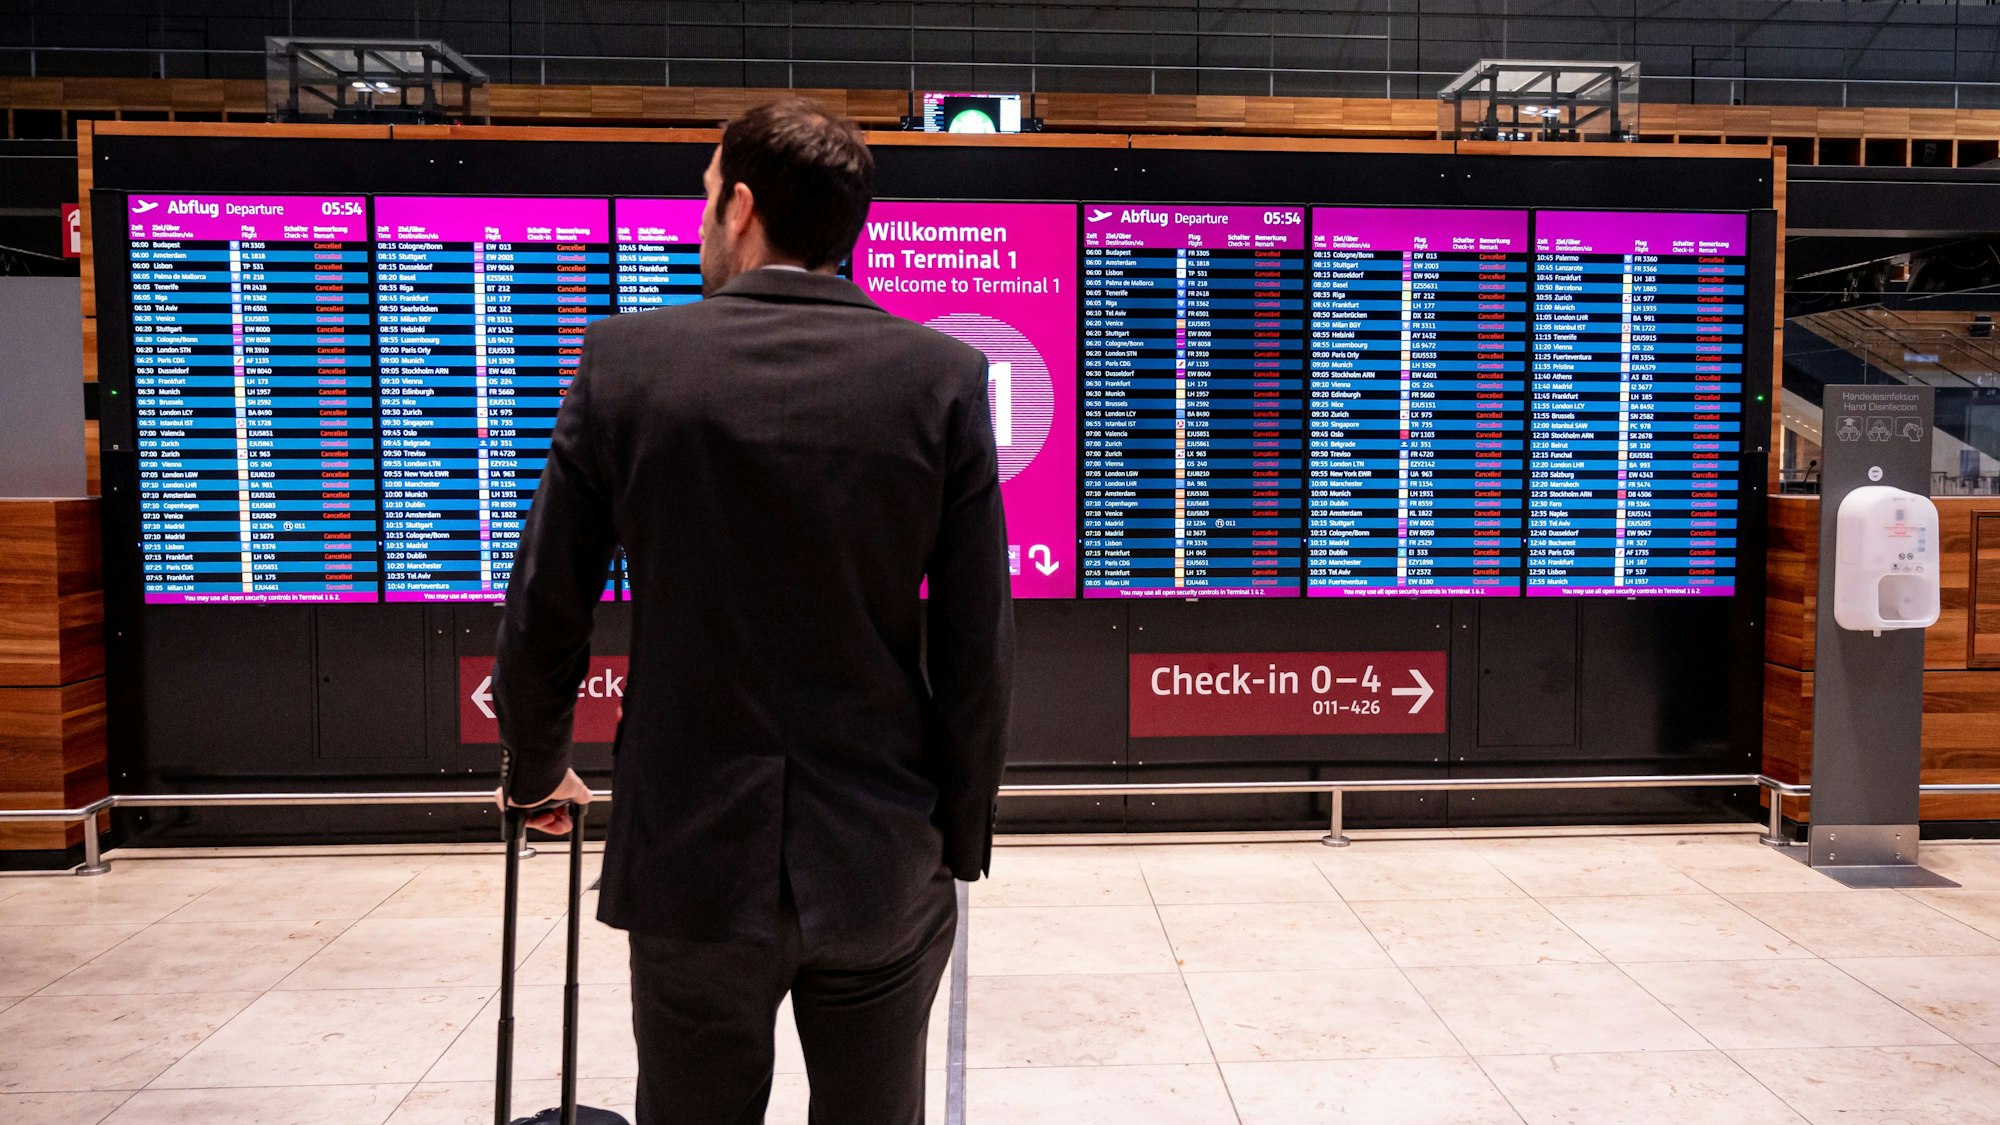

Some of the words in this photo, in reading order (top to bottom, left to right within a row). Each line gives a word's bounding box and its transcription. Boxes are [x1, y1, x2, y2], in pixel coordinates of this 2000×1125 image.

[168, 199, 219, 218] Abflug
[226, 203, 284, 217] Departure
[322, 202, 362, 216] 05:54
[1121, 210, 1169, 226] Abflug
[1175, 213, 1228, 226] Departure
[1263, 212, 1301, 225] 05:54
[868, 222, 1007, 242] Willkommen
[398, 243, 443, 251] Cologne/Bonn
[1106, 249, 1131, 257] Budapest
[868, 248, 895, 269] im
[901, 250, 999, 269] Terminal
[1008, 251, 1016, 269] 1
[1333, 252, 1374, 260] Cologne/Bonn
[868, 277, 946, 293] Welcome
[951, 278, 968, 292] to
[973, 278, 1047, 293] Terminal
[1052, 278, 1060, 293] 1
[156, 325, 182, 333] Stuttgart
[1844, 403, 1866, 411] Hand
[1869, 403, 1917, 411] Disinfection
[384, 470, 402, 478] 09:55
[1151, 664, 1298, 695] Check-in
